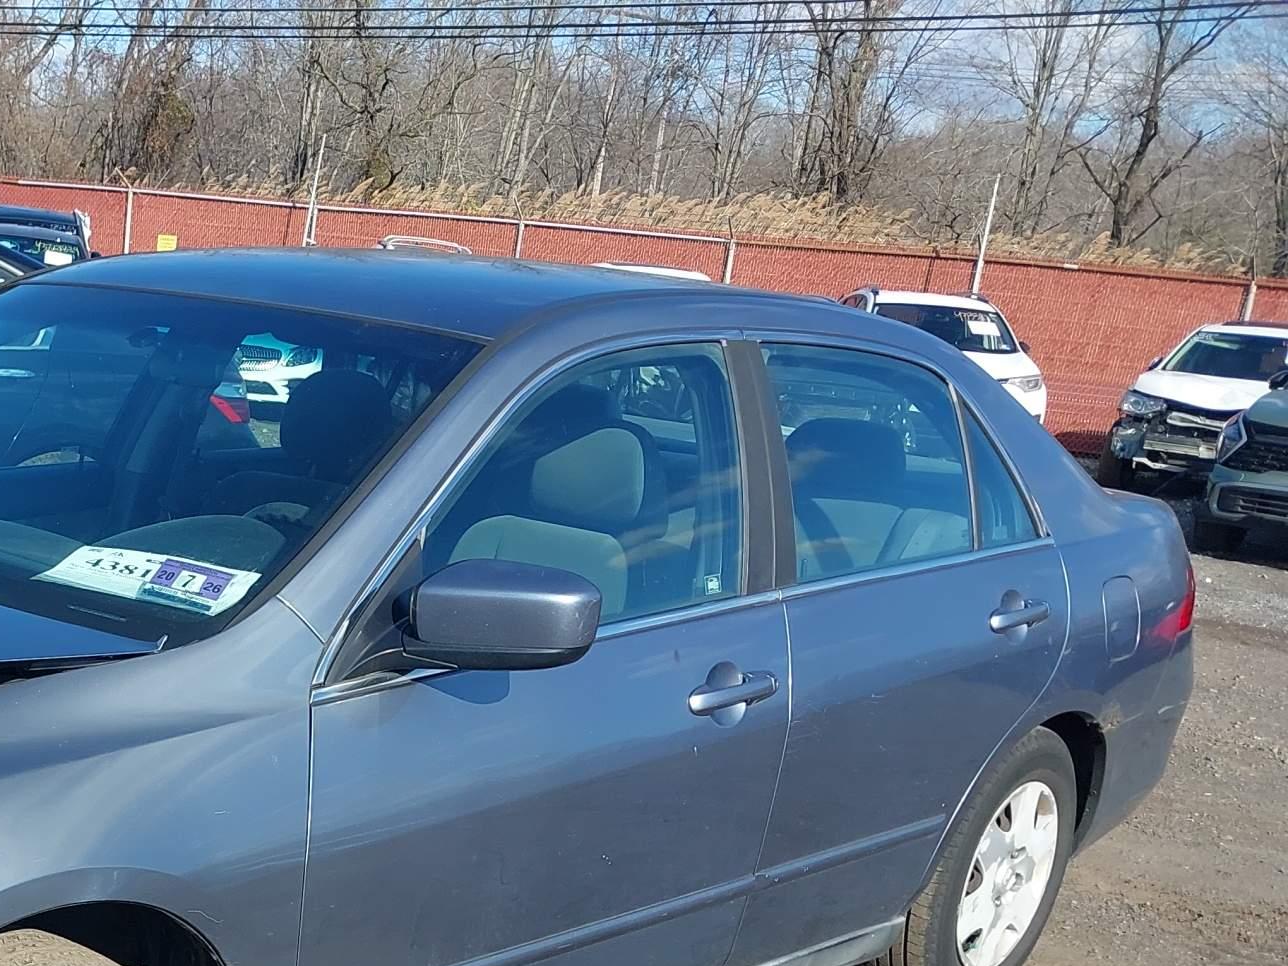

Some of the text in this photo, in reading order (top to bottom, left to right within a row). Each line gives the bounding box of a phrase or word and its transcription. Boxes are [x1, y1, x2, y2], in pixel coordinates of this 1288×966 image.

[85, 558, 152, 578] 4381
[157, 570, 223, 593] 20 7 26
